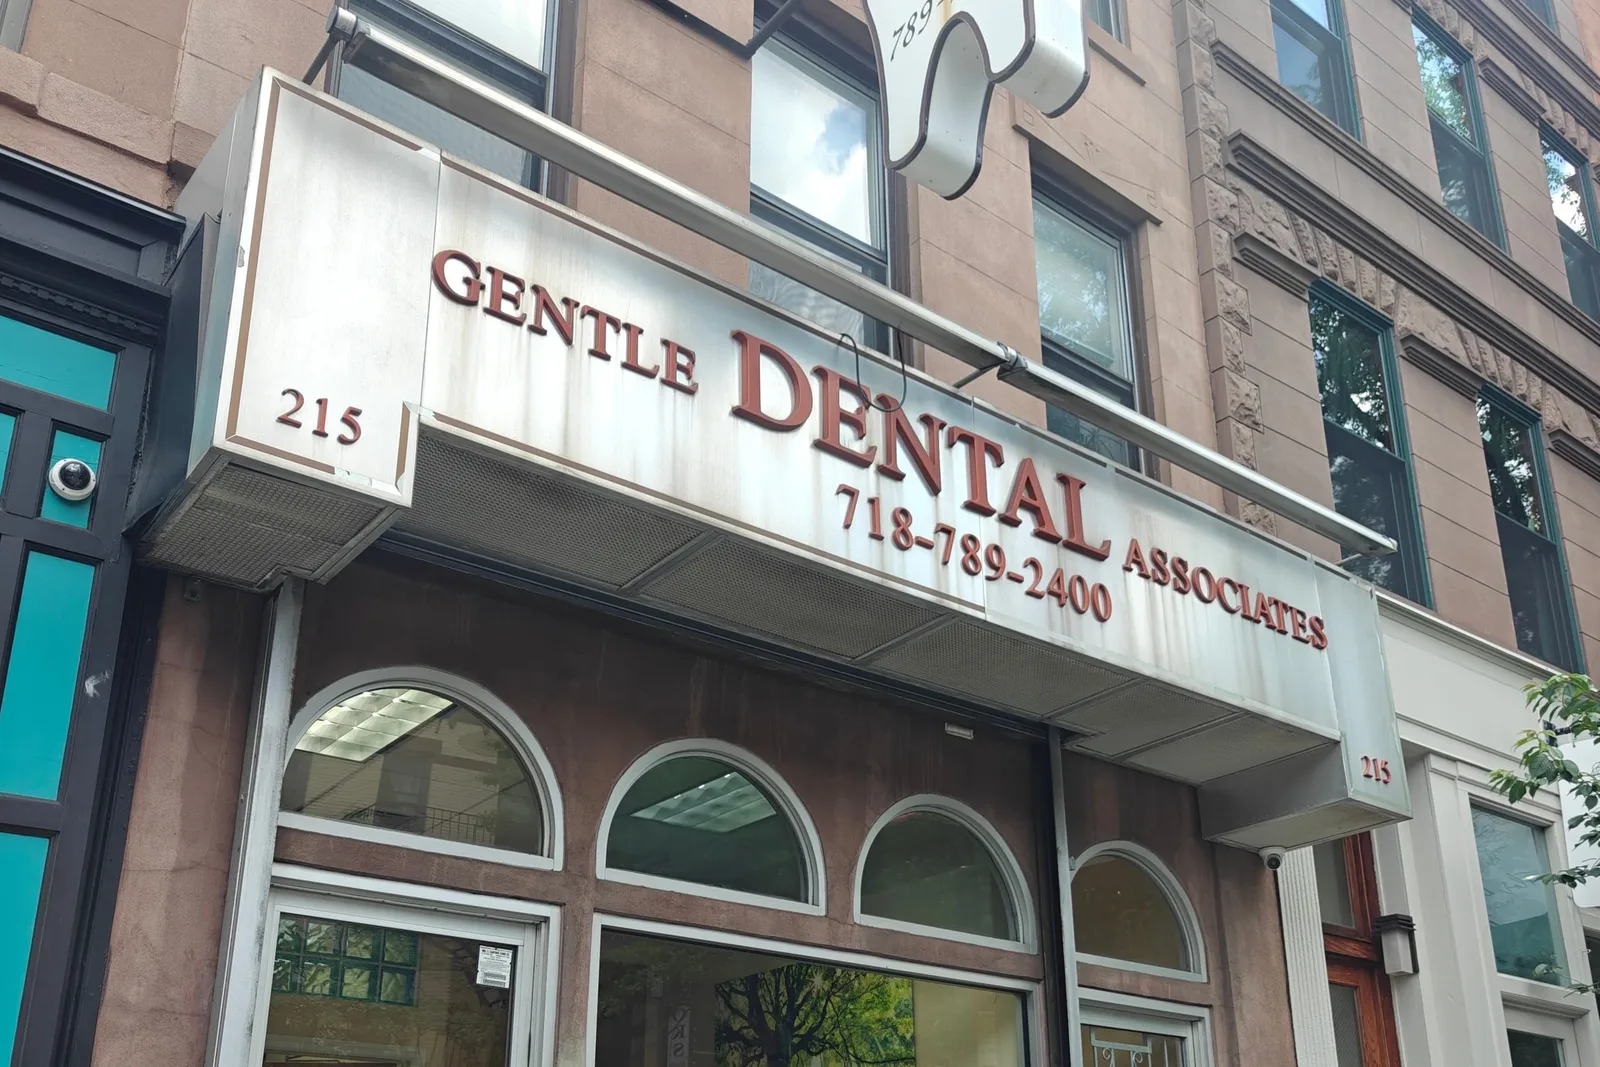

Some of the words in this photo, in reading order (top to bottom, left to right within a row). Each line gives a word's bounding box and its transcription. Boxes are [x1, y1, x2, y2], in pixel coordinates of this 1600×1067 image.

[889, 0, 953, 62] 789-
[276, 388, 362, 445] 215
[431, 249, 699, 395] GENTLE
[731, 329, 1111, 561] DENTAL
[1122, 538, 1328, 650] ASSOCIATES
[835, 483, 1112, 623] 718-789-2400
[1360, 755, 1392, 785] 215
